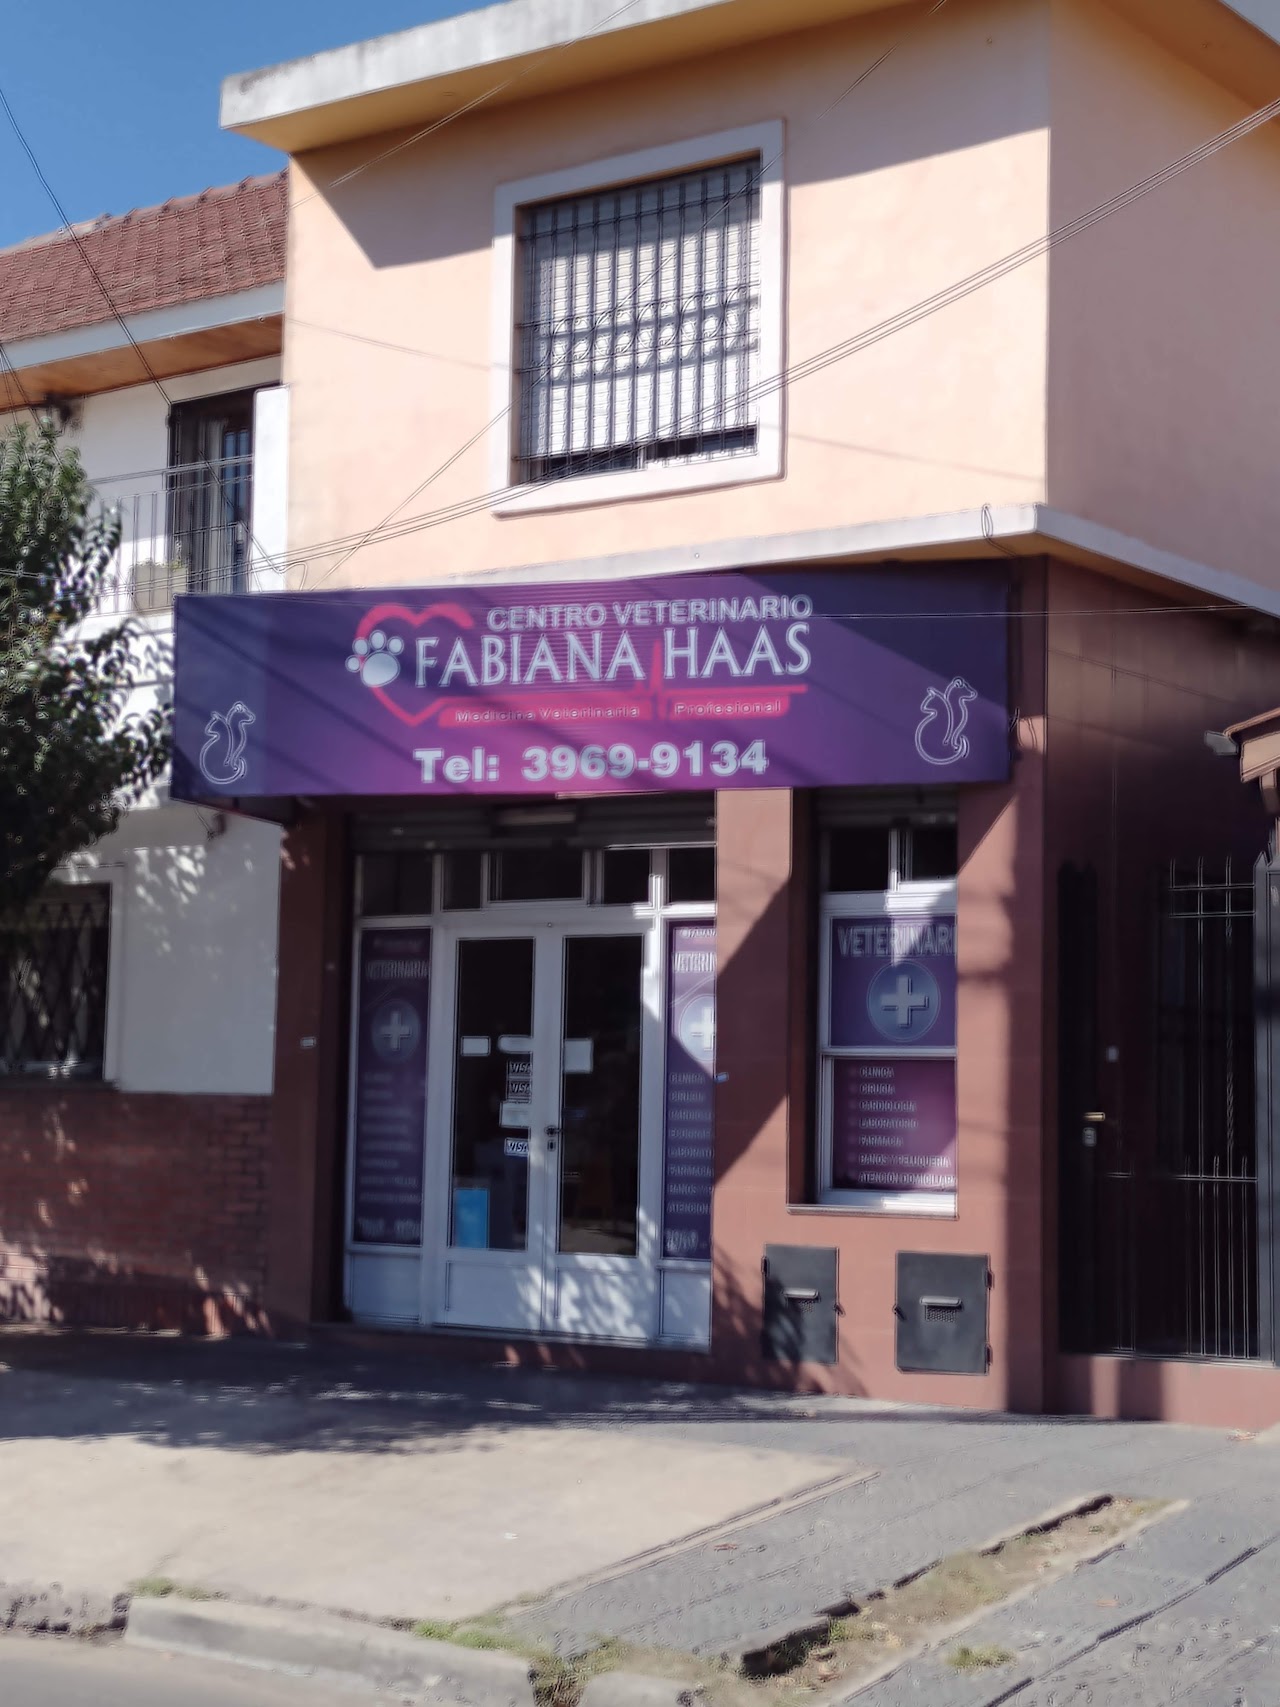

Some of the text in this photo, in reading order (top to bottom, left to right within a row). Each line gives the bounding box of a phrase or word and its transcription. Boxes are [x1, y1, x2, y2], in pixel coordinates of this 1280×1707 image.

[486, 595, 813, 632] CENTRO VETERINARIO
[415, 621, 811, 687] FABIANA HAAS
[455, 699, 782, 723] Medicina Veterinaria Profesional
[413, 739, 769, 783] Tel: 3969-9134
